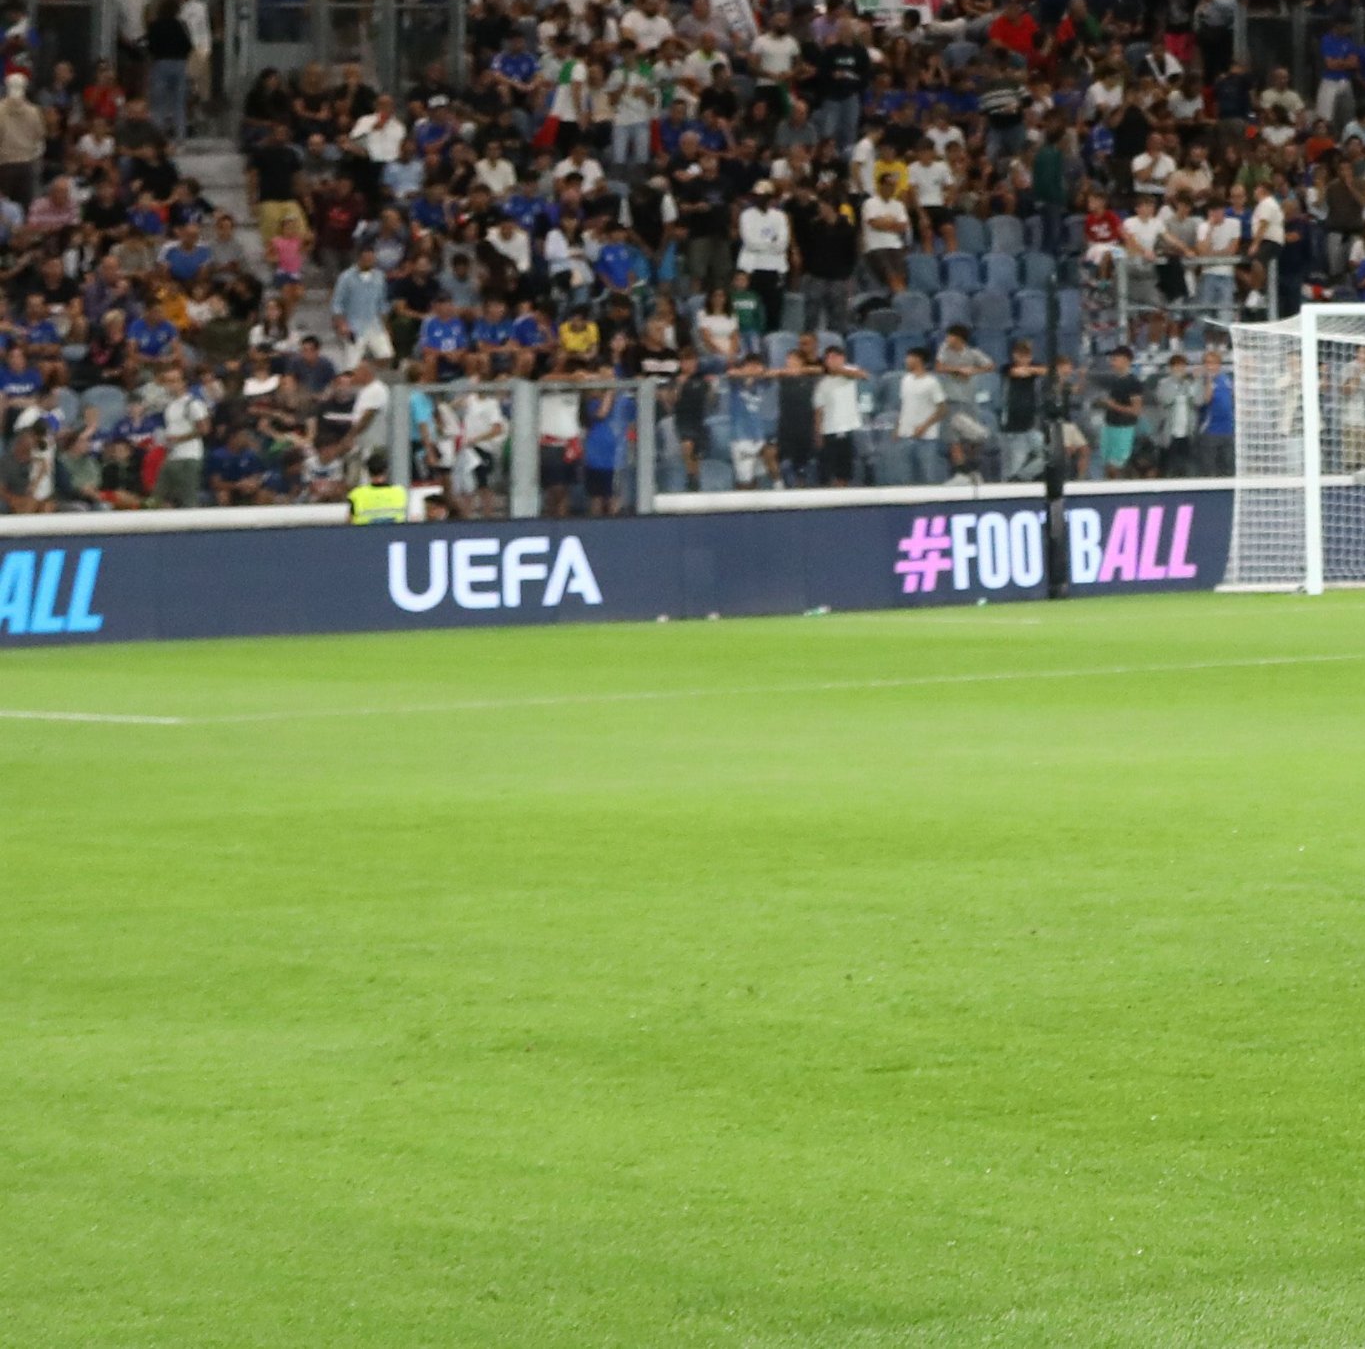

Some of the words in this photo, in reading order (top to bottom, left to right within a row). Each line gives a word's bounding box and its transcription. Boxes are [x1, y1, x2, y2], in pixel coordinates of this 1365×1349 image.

[0, 547, 104, 635] ALL
[388, 536, 603, 611] UEFA
[894, 504, 1198, 593] #FOOBALL
